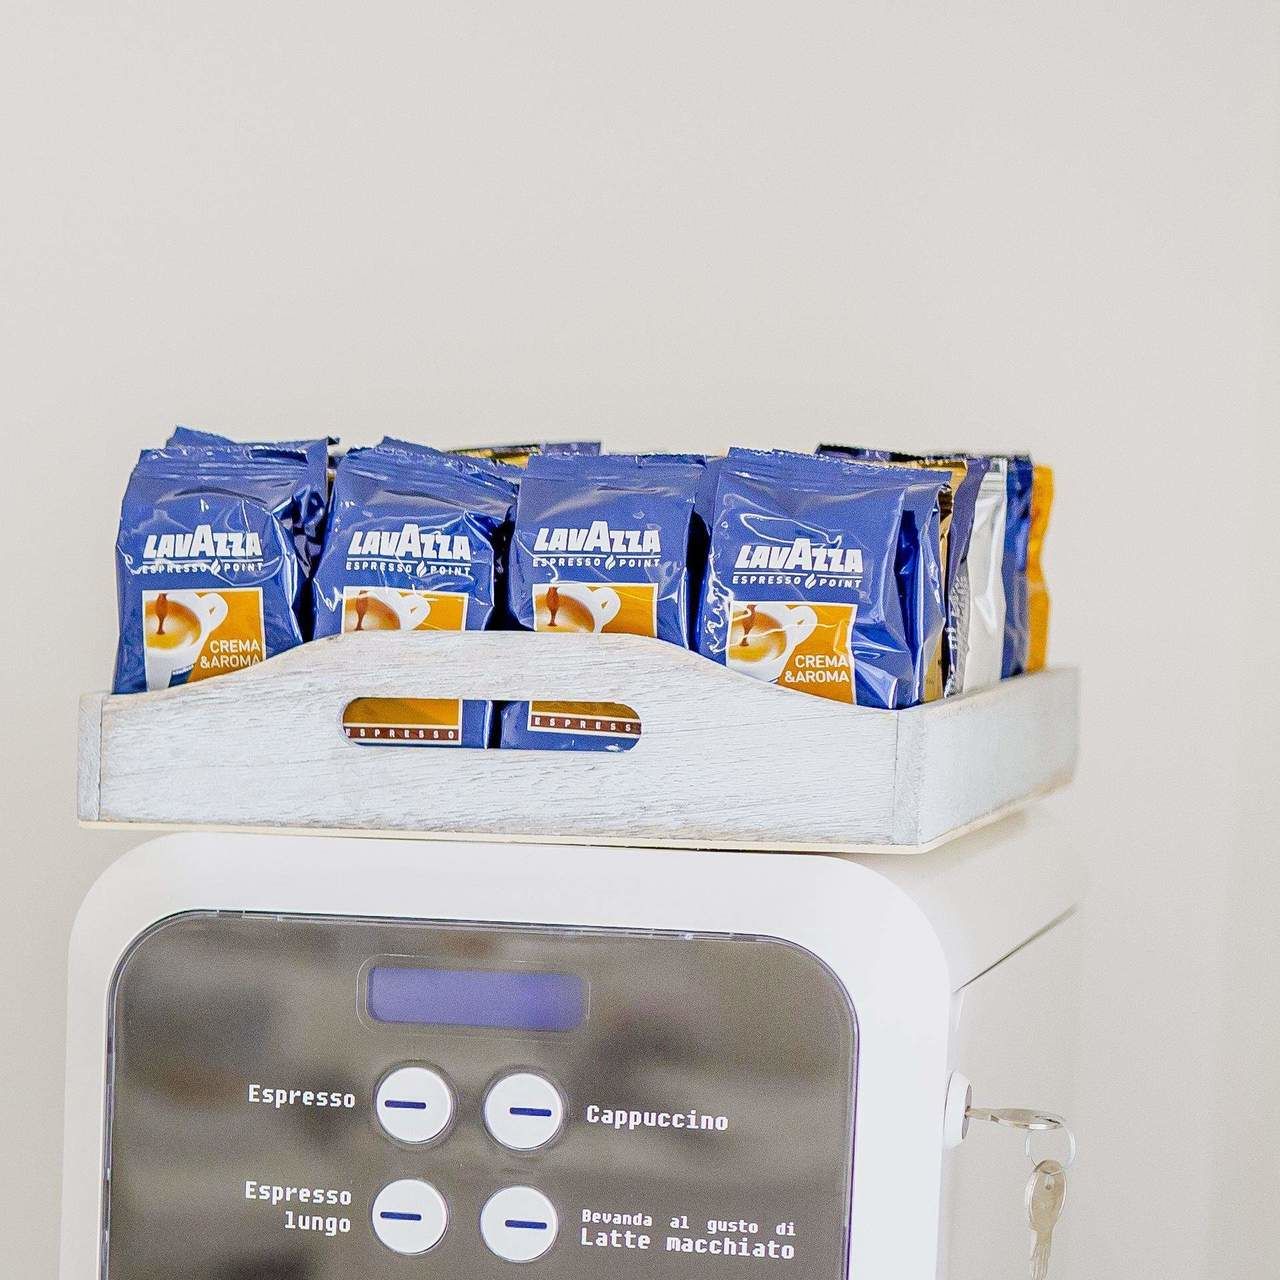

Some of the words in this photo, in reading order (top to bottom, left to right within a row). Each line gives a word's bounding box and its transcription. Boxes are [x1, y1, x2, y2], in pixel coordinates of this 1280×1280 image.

[143, 525, 262, 558] LAVAZZA
[347, 523, 471, 560] LAVAZZA
[533, 521, 661, 552] LAVAZZA
[532, 558, 600, 567] ESPRESSO
[619, 559, 660, 567] POINT
[734, 538, 863, 572] LAVAZZA
[142, 563, 207, 575] ESPRESSO
[224, 562, 263, 572] POINT
[346, 562, 412, 573] ESPRESSO
[430, 566, 471, 576] POINT
[732, 575, 802, 585] ESPRESSO
[819, 578, 862, 589] POINT
[209, 639, 261, 654] CREMA
[200, 654, 261, 669] &AROMA
[795, 655, 850, 668] CREMA
[785, 670, 850, 683] &AROMA
[345, 728, 455, 740] ESPRESSO
[534, 716, 633, 732] ESPRESS
[247, 1083, 356, 1109] Espresso
[586, 1105, 729, 1131] Cappuccino
[244, 1180, 352, 1206] Espresso
[284, 1210, 351, 1237] lungo
[581, 1208, 653, 1227] Bevanda
[669, 1216, 690, 1230] al
[706, 1219, 759, 1235] gusto
[775, 1221, 796, 1236] di
[580, 1227, 651, 1250] Latte
[665, 1236, 795, 1260] macchiato
